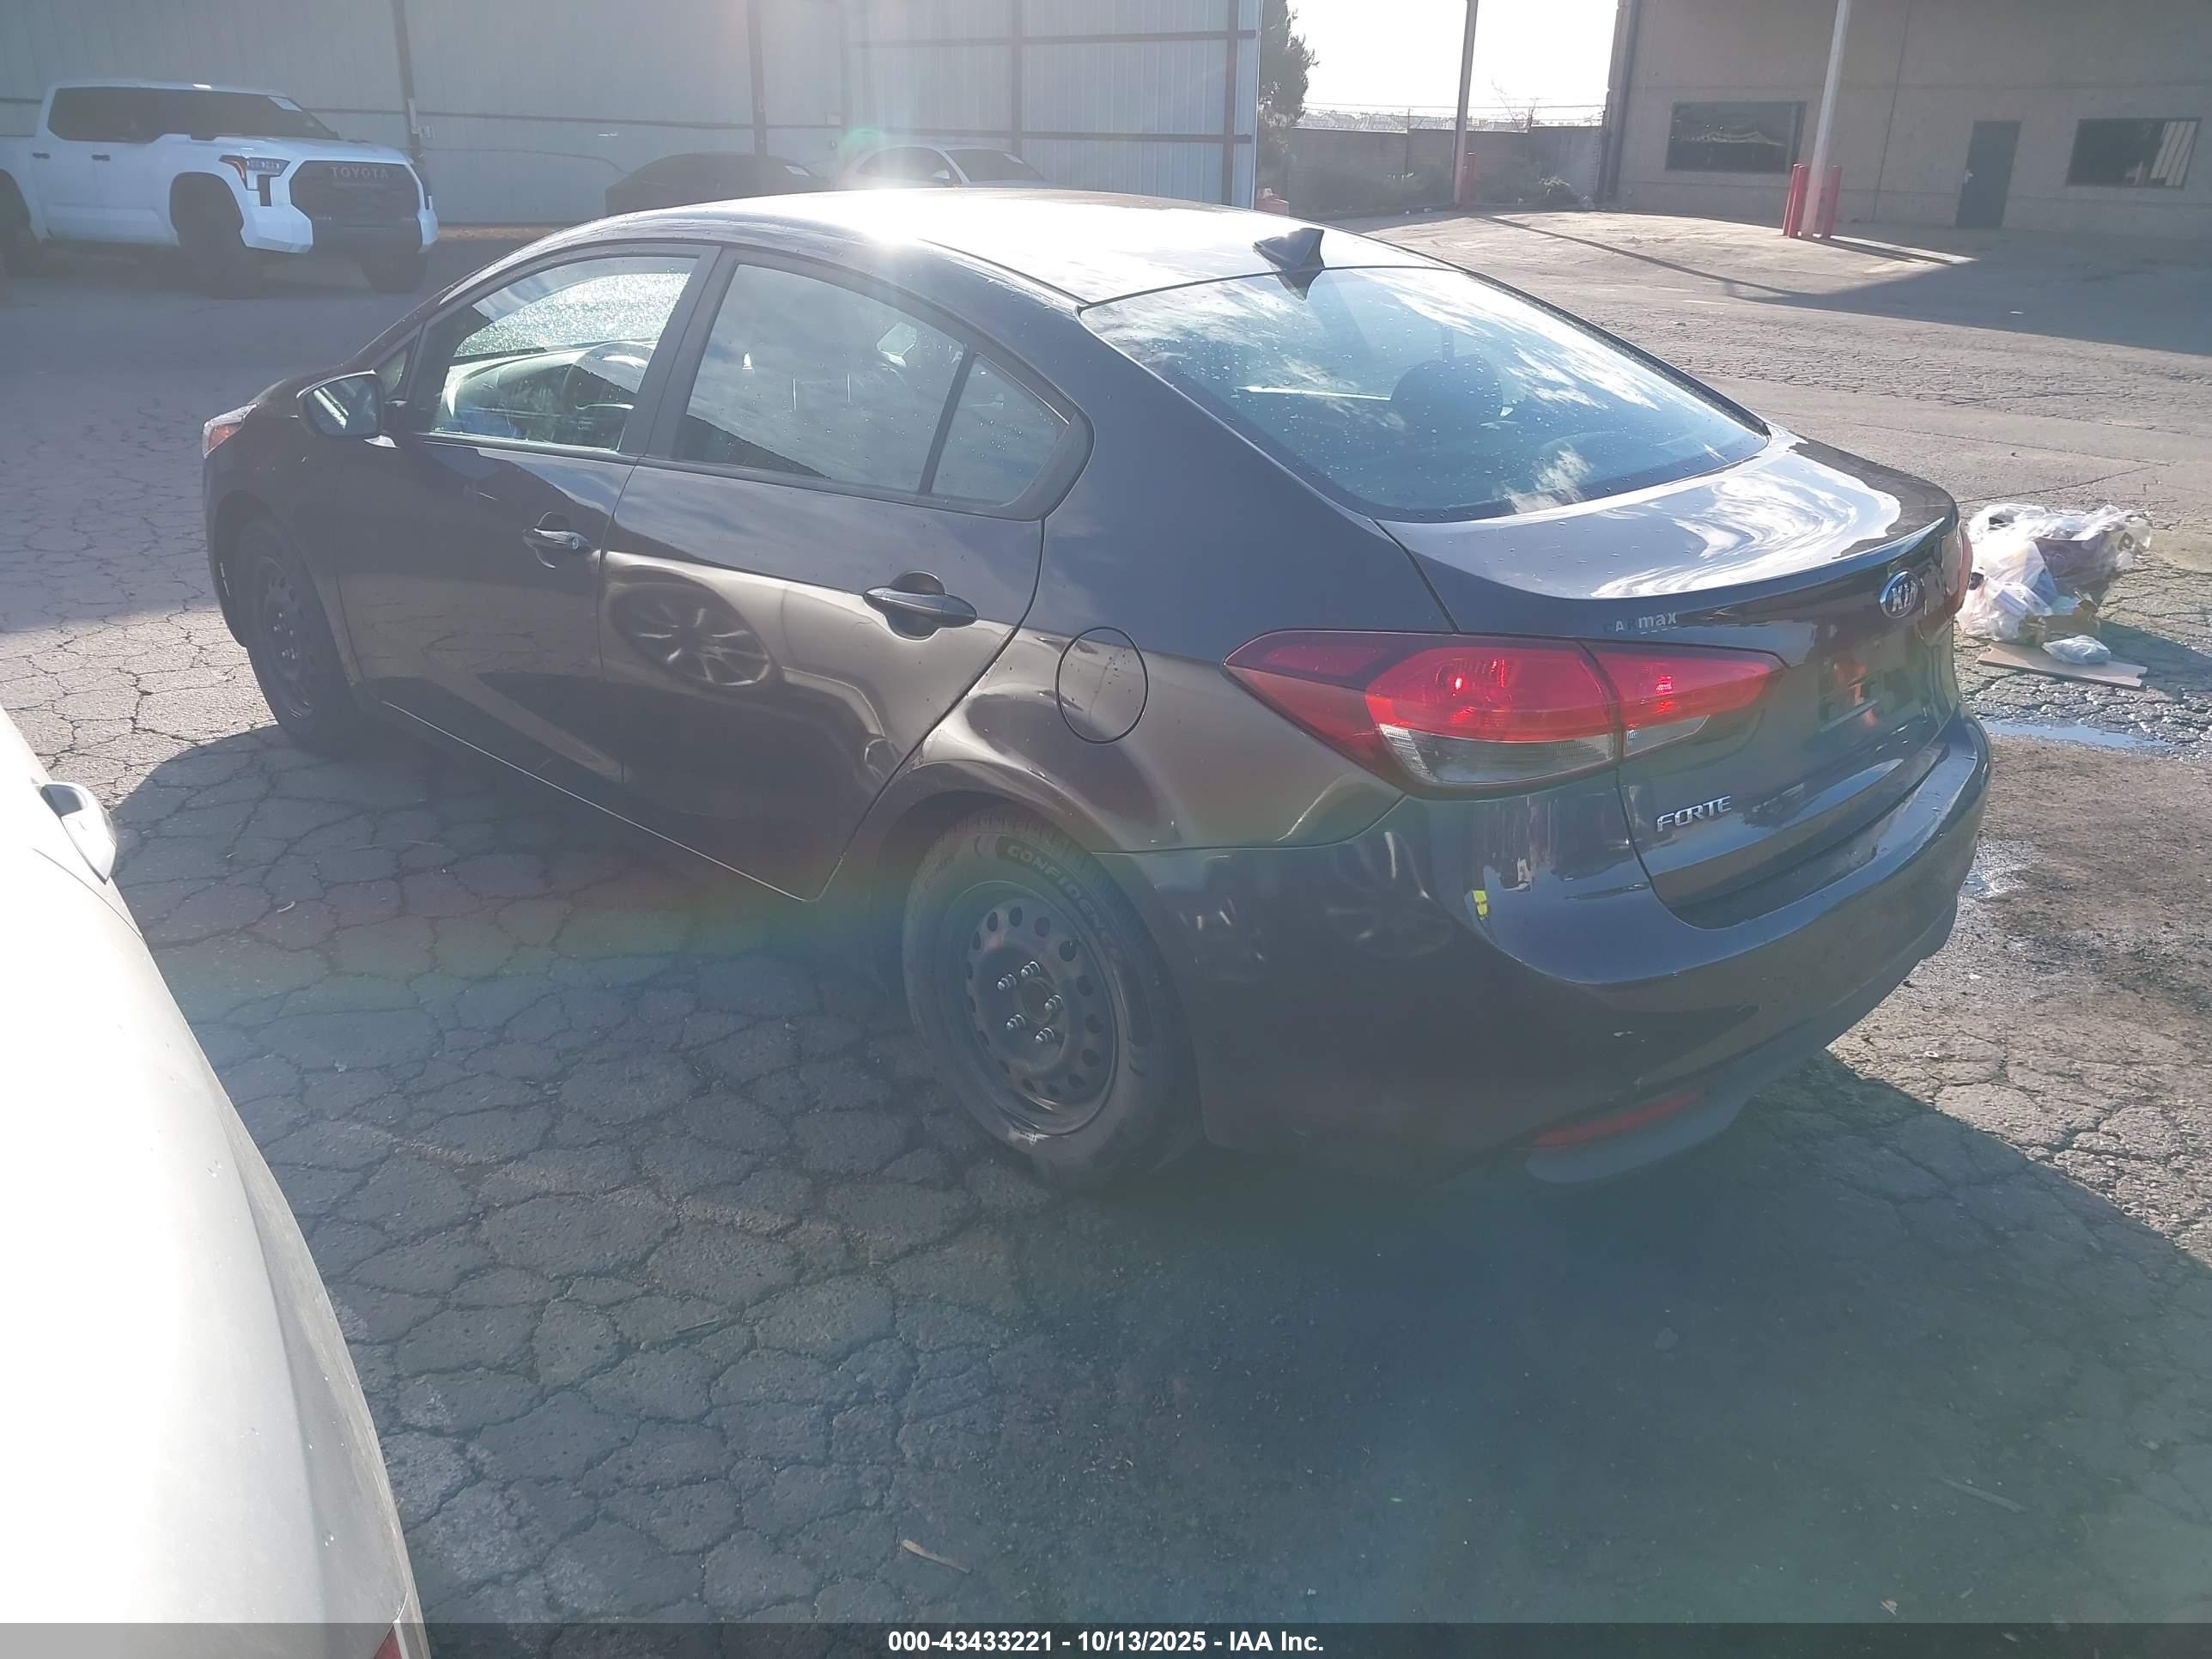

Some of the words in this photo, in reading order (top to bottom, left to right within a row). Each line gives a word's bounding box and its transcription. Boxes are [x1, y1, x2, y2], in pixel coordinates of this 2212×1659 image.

[330, 166, 389, 179] TOYOTA
[1891, 580, 1917, 612] KIA
[1656, 795, 1732, 832] FORTE
